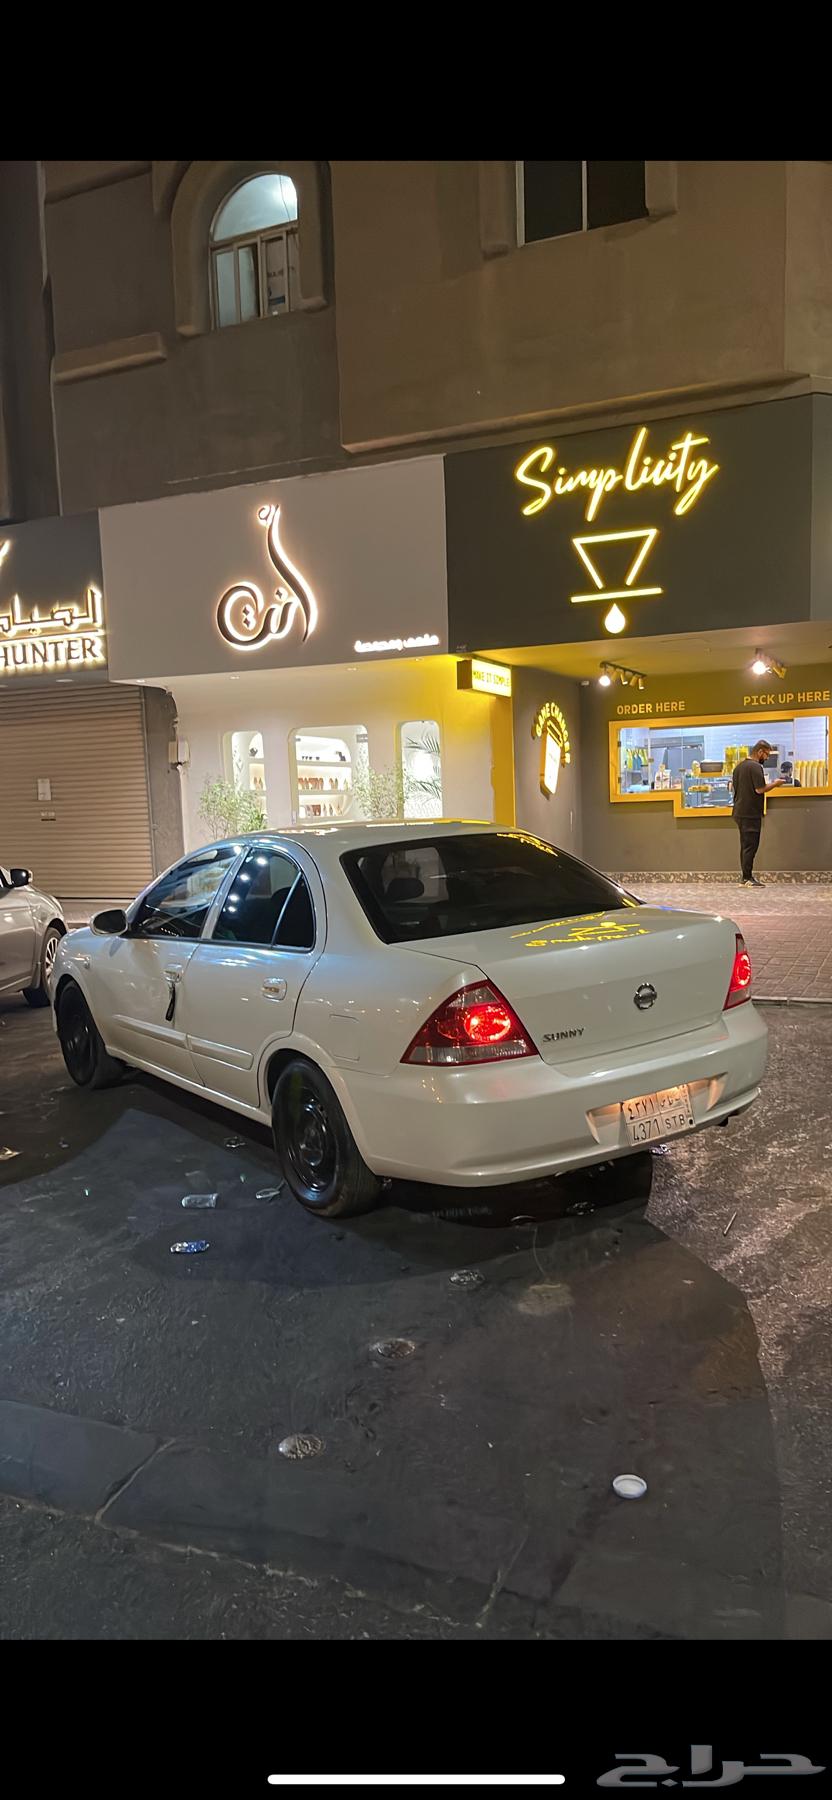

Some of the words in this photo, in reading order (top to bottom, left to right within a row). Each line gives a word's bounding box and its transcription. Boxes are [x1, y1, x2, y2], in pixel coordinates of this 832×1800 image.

[516, 427, 719, 521] Simplicity
[743, 694, 775, 706] PICK
[778, 693, 794, 704] UP
[797, 690, 831, 703] HERE
[617, 703, 653, 715] ORDER
[656, 701, 686, 712] HERE
[543, 1028, 584, 1042] SUNNY
[633, 1118, 661, 1141] 4371
[665, 1114, 686, 1130] STB
